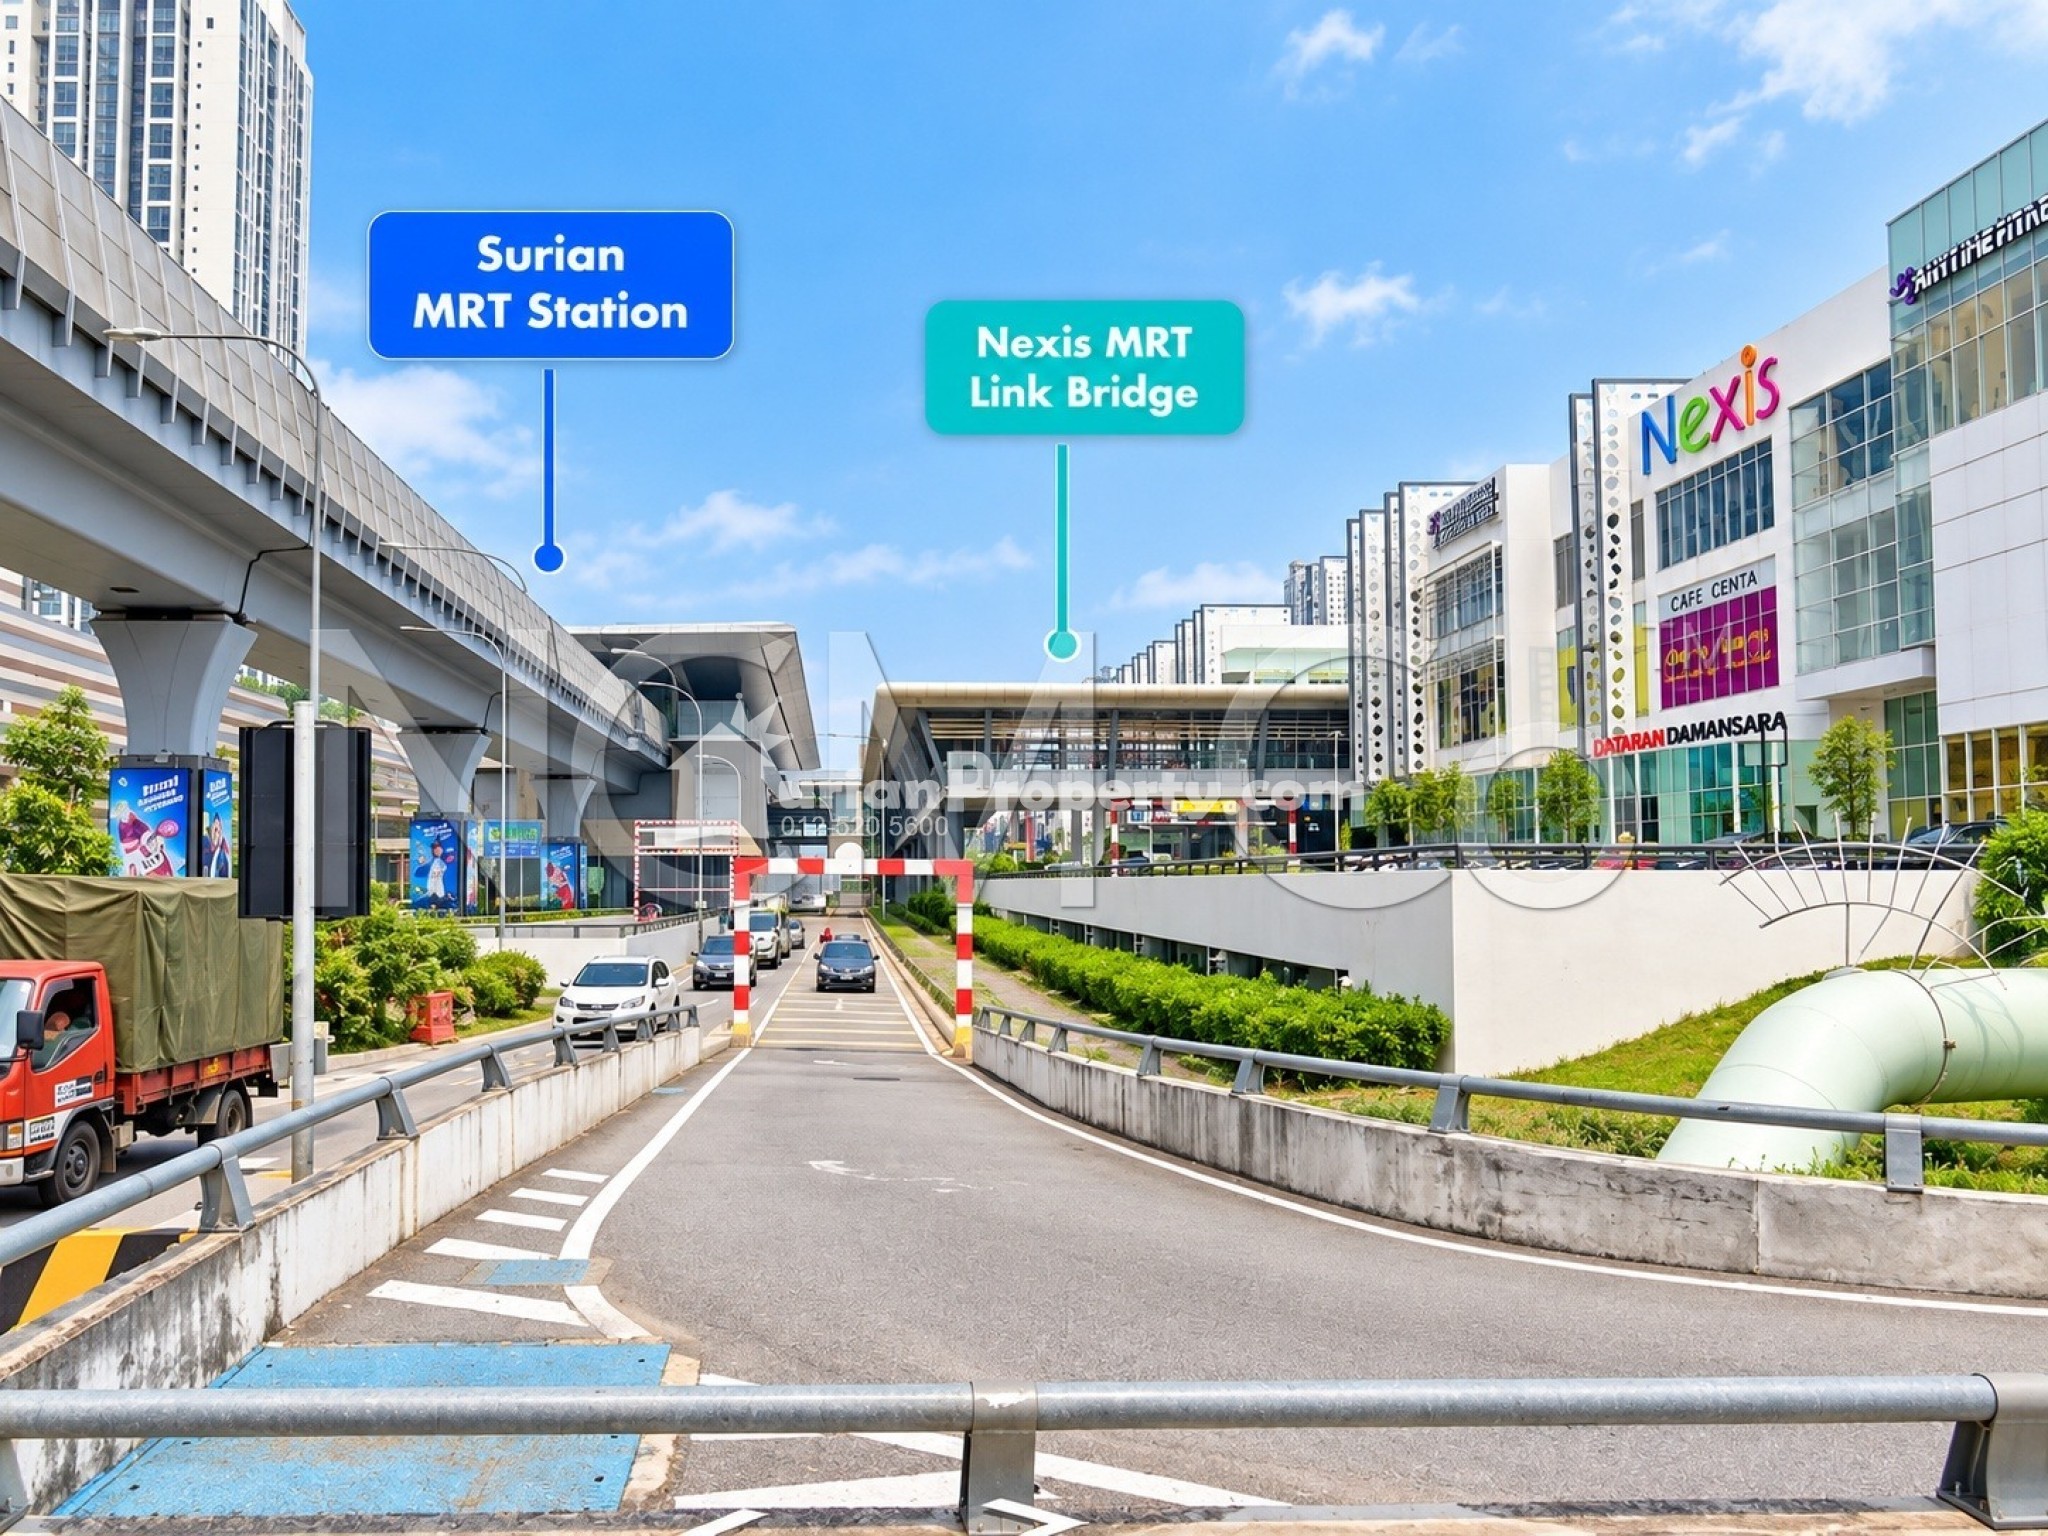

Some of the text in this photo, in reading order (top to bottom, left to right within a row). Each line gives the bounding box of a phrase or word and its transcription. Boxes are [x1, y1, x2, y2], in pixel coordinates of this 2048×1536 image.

[1640, 344, 1780, 476] Nexis
[1671, 570, 1758, 612] CAFE CENTA
[1593, 711, 1788, 758] DATARAN DAMANSARA
